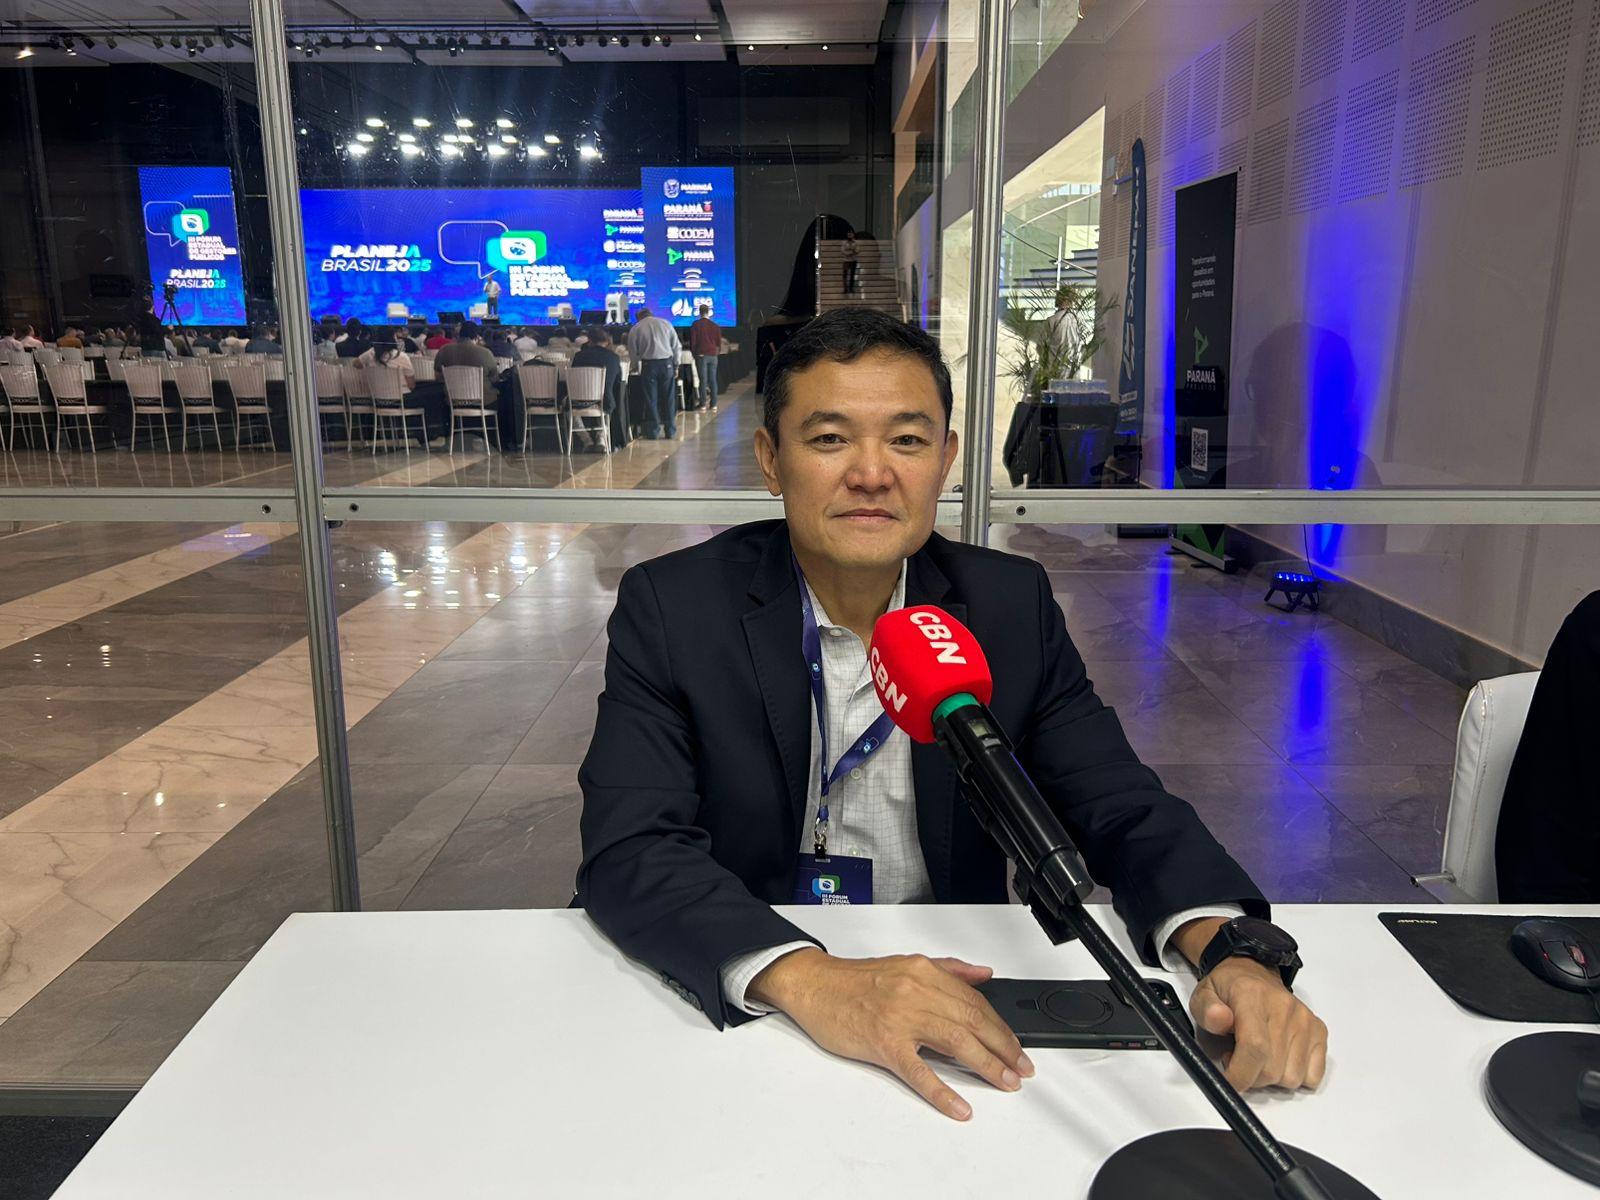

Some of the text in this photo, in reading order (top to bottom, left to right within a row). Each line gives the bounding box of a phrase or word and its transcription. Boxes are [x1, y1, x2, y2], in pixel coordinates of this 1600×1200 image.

[330, 244, 421, 258] PLANEJA
[321, 259, 432, 272] BRASIL2025
[170, 268, 220, 279] PLANEJA
[1186, 368, 1216, 383] PARANÁ
[909, 611, 967, 665] CBN
[871, 646, 908, 713] CBN
